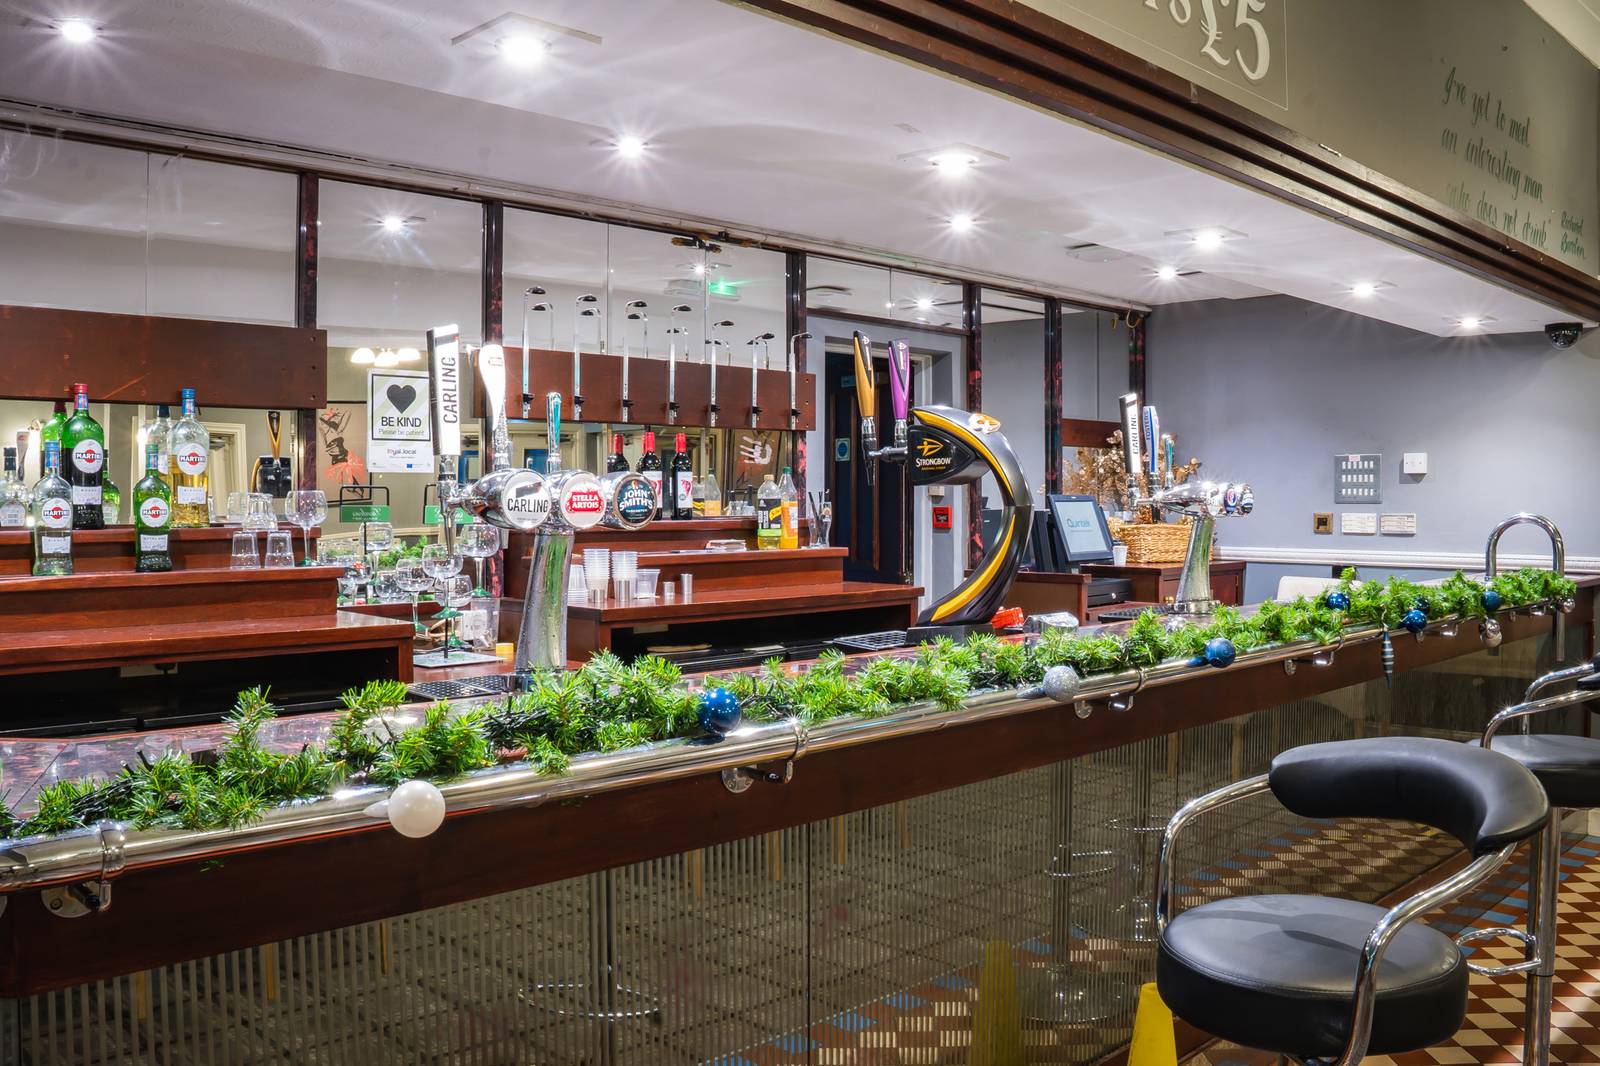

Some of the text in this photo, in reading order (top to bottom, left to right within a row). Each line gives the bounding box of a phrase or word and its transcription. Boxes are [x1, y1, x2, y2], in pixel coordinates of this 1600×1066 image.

[1472, 91, 1490, 126] yet
[1496, 100, 1506, 131] to
[1509, 117, 1530, 148] meet
[1441, 128, 1543, 203] an interesting man
[1477, 190, 1498, 228] does
[1503, 208, 1518, 237] not
[441, 357, 458, 424] CARLING
[381, 416, 422, 428] BE KIND
[915, 457, 952, 468] STRONGBOW
[572, 494, 599, 502] STELLA
[623, 489, 649, 500] JOHN
[507, 498, 549, 513] CARLING
